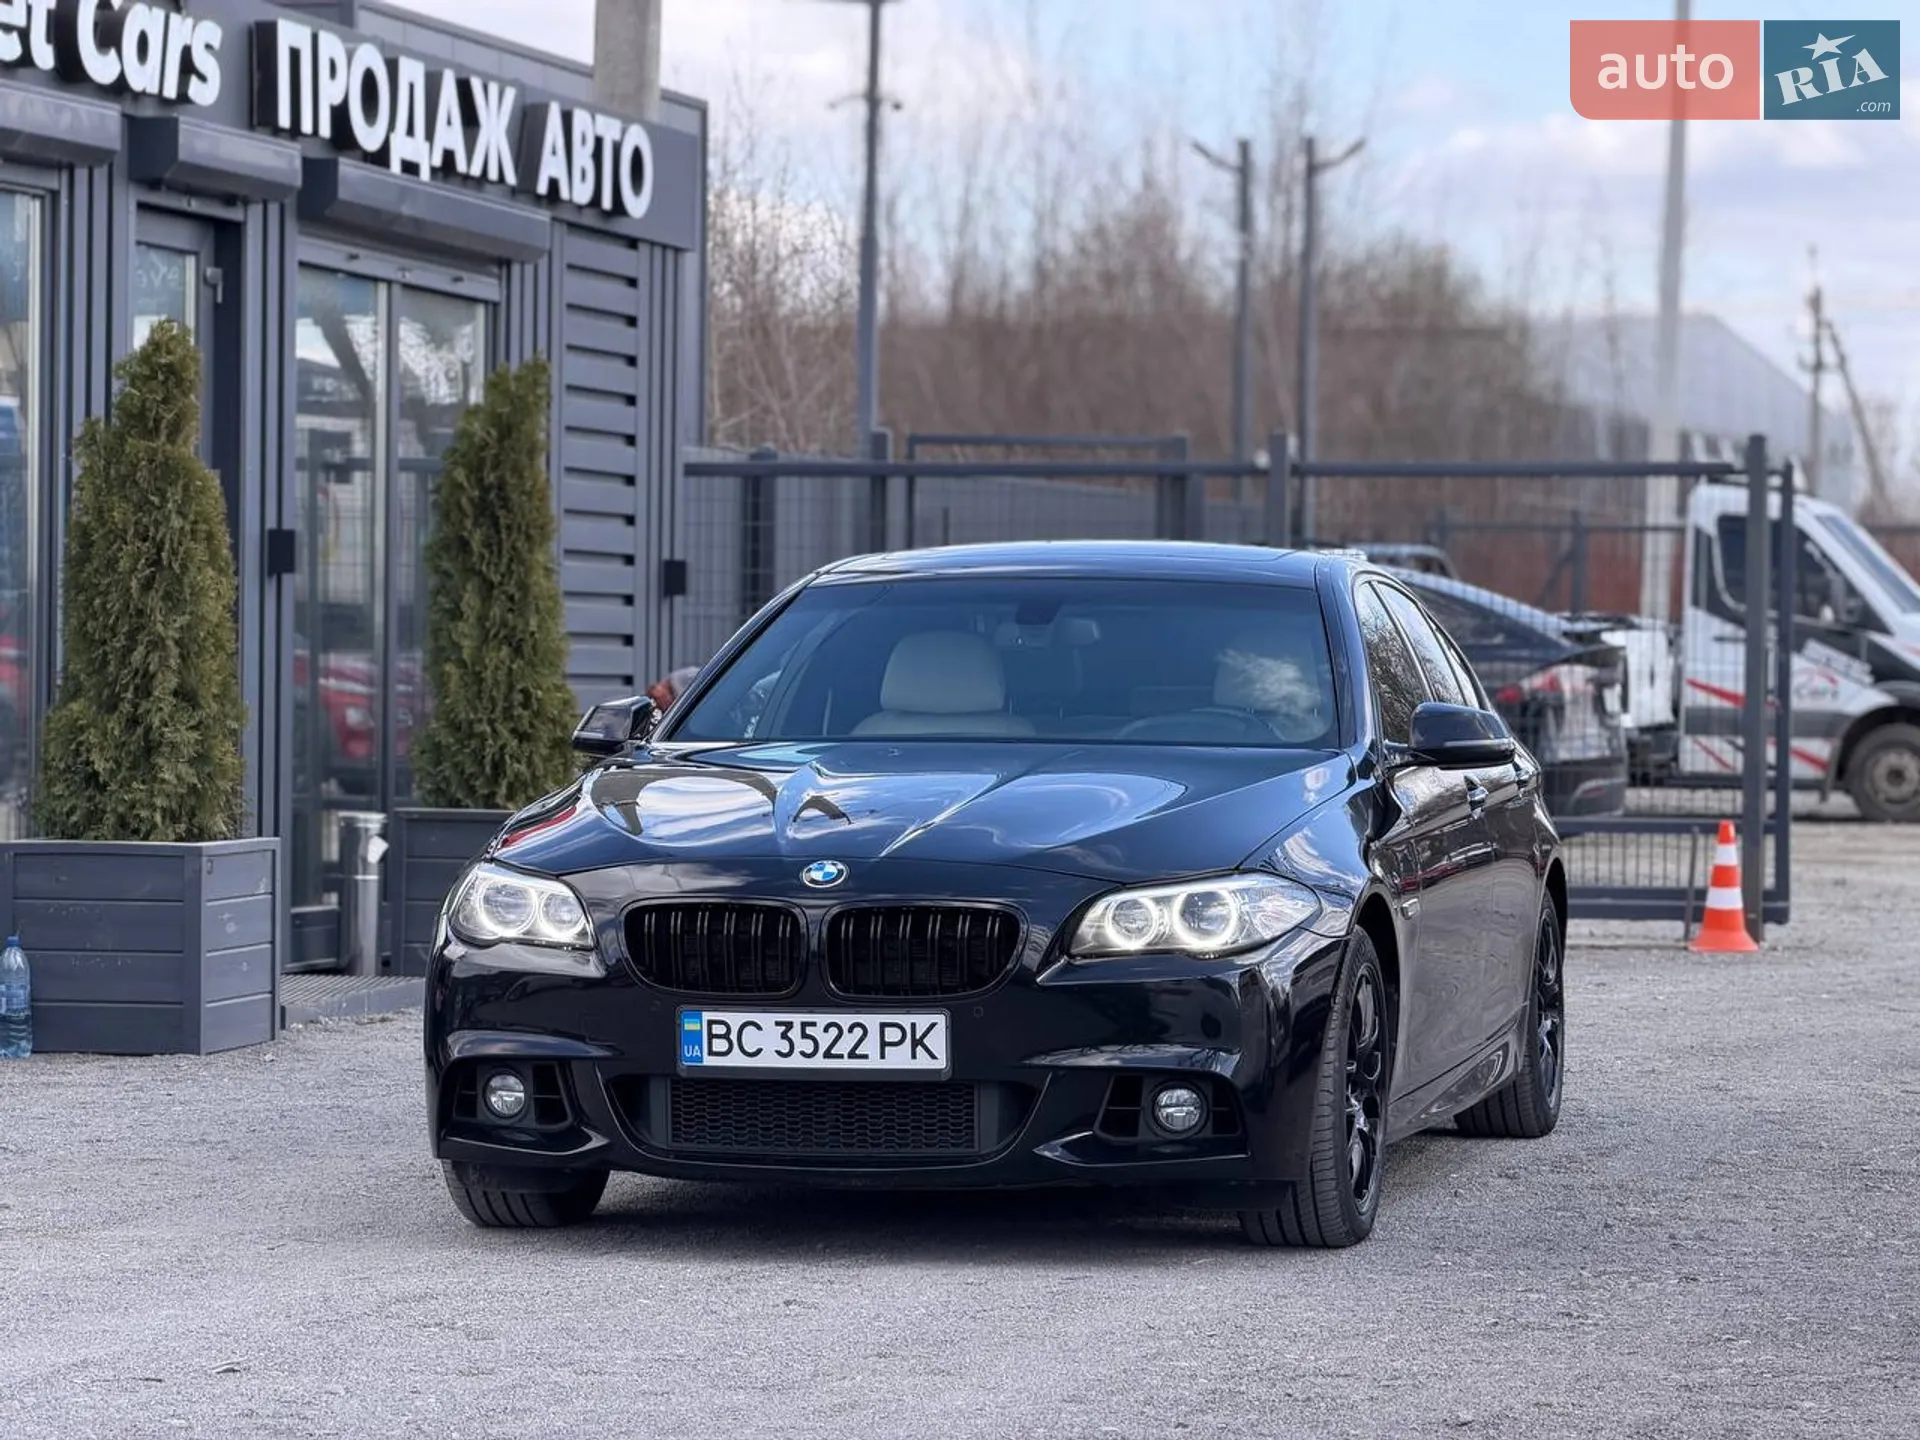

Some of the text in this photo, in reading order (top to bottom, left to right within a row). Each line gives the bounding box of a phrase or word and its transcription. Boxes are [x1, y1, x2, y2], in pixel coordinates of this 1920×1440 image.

[77, 0, 223, 107] Cars
[277, 17, 654, 219] ПРОДАЖ АВТО
[684, 1045, 702, 1058] UA
[706, 1018, 939, 1060] BC 3522 PK
